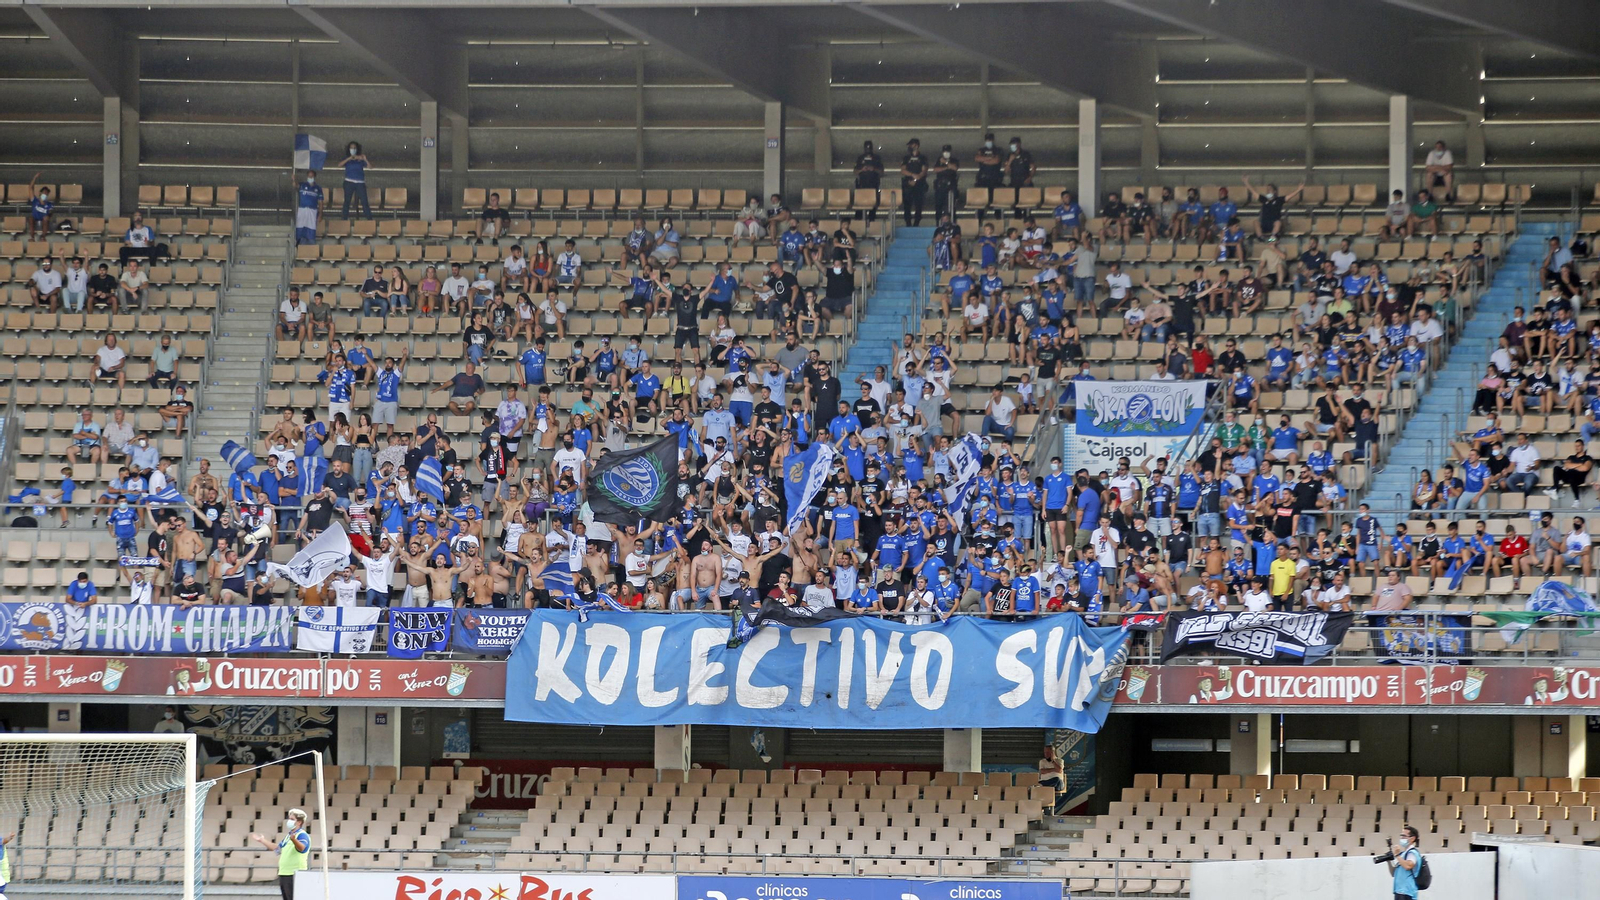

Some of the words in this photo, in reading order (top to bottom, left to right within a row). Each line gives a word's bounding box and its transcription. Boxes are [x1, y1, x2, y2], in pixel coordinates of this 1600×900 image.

[1111, 385, 1171, 394] KOMANDO
[1088, 440, 1147, 461] Cajasol
[86, 604, 176, 652] FROM
[392, 611, 449, 630] NEW
[479, 615, 527, 626] YOUTH
[1215, 628, 1278, 658] KS91
[23, 665, 36, 687] SIN
[535, 621, 953, 711] KOLECTIVO
[214, 661, 360, 695] Cruzcampo
[370, 669, 381, 691] SIN
[403, 679, 432, 692] Xerez
[433, 675, 447, 687] CD
[1236, 669, 1378, 703] Cruzcampo
[1387, 675, 1399, 697] SIN
[756, 882, 808, 897] clínicas
[950, 885, 1002, 899] clínicas
